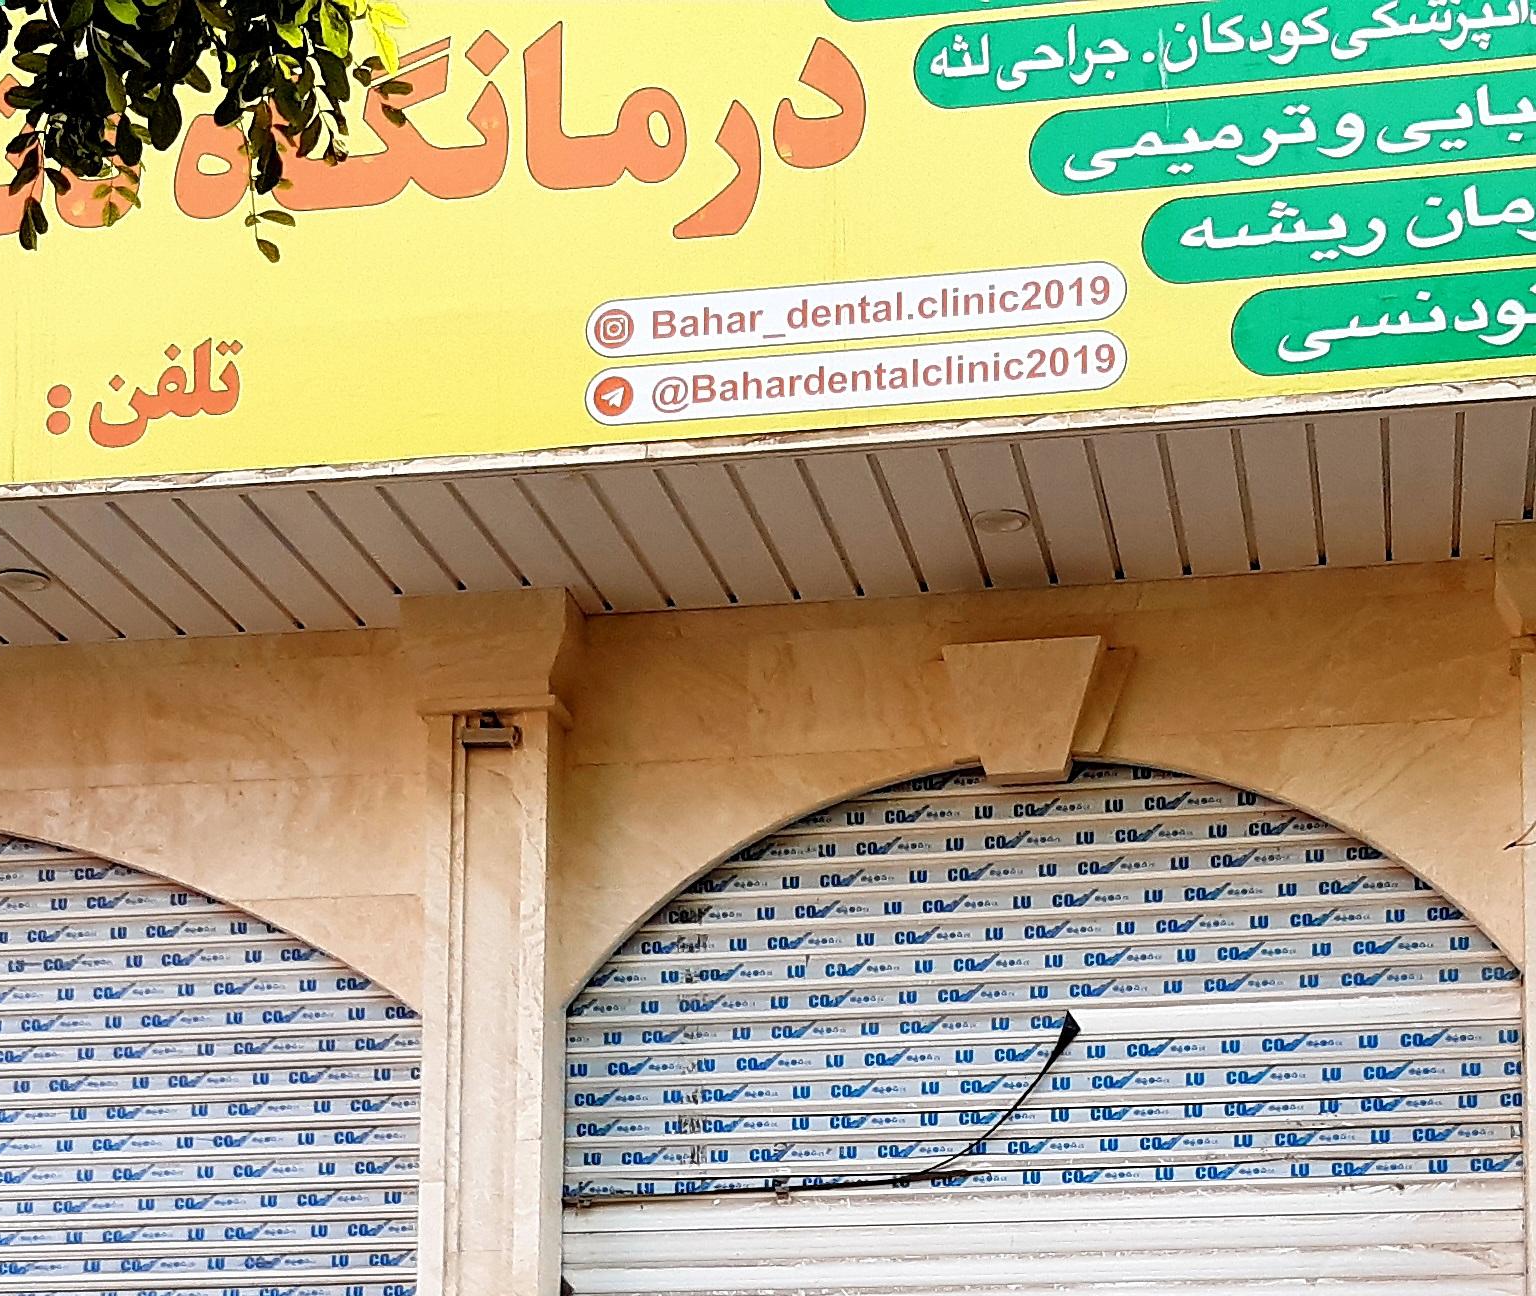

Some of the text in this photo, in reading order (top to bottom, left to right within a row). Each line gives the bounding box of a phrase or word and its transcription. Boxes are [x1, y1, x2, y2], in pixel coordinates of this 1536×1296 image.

[930, 33, 991, 79] لثه
[995, 24, 1131, 91] جراحی
[174, 20, 867, 240] درمانگاه
[1063, 105, 1318, 182] ترمیمی
[1316, 112, 1366, 158] و
[1179, 199, 1388, 261] ریشه
[652, 275, 1110, 340] Bahar_dental.clinic2019
[652, 343, 1116, 413] @Bahardentalclinic2019
